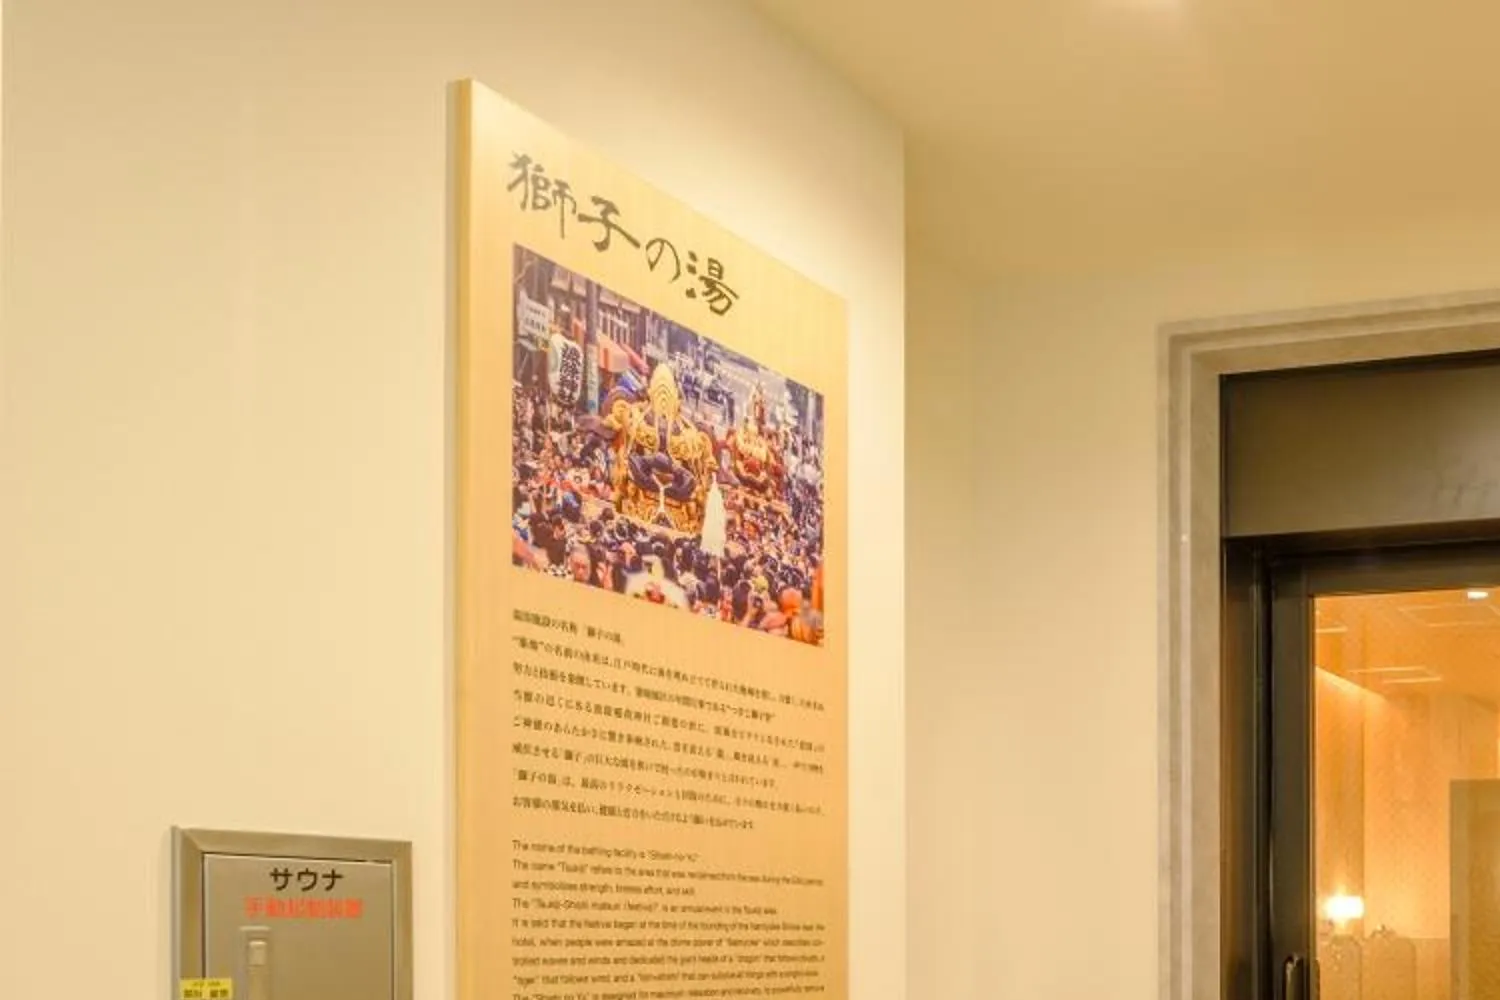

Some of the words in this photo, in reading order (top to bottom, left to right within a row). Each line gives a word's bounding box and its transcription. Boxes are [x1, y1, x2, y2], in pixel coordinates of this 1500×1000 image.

[507, 151, 740, 317] 獅子の湯
[269, 867, 344, 892] サウナ
